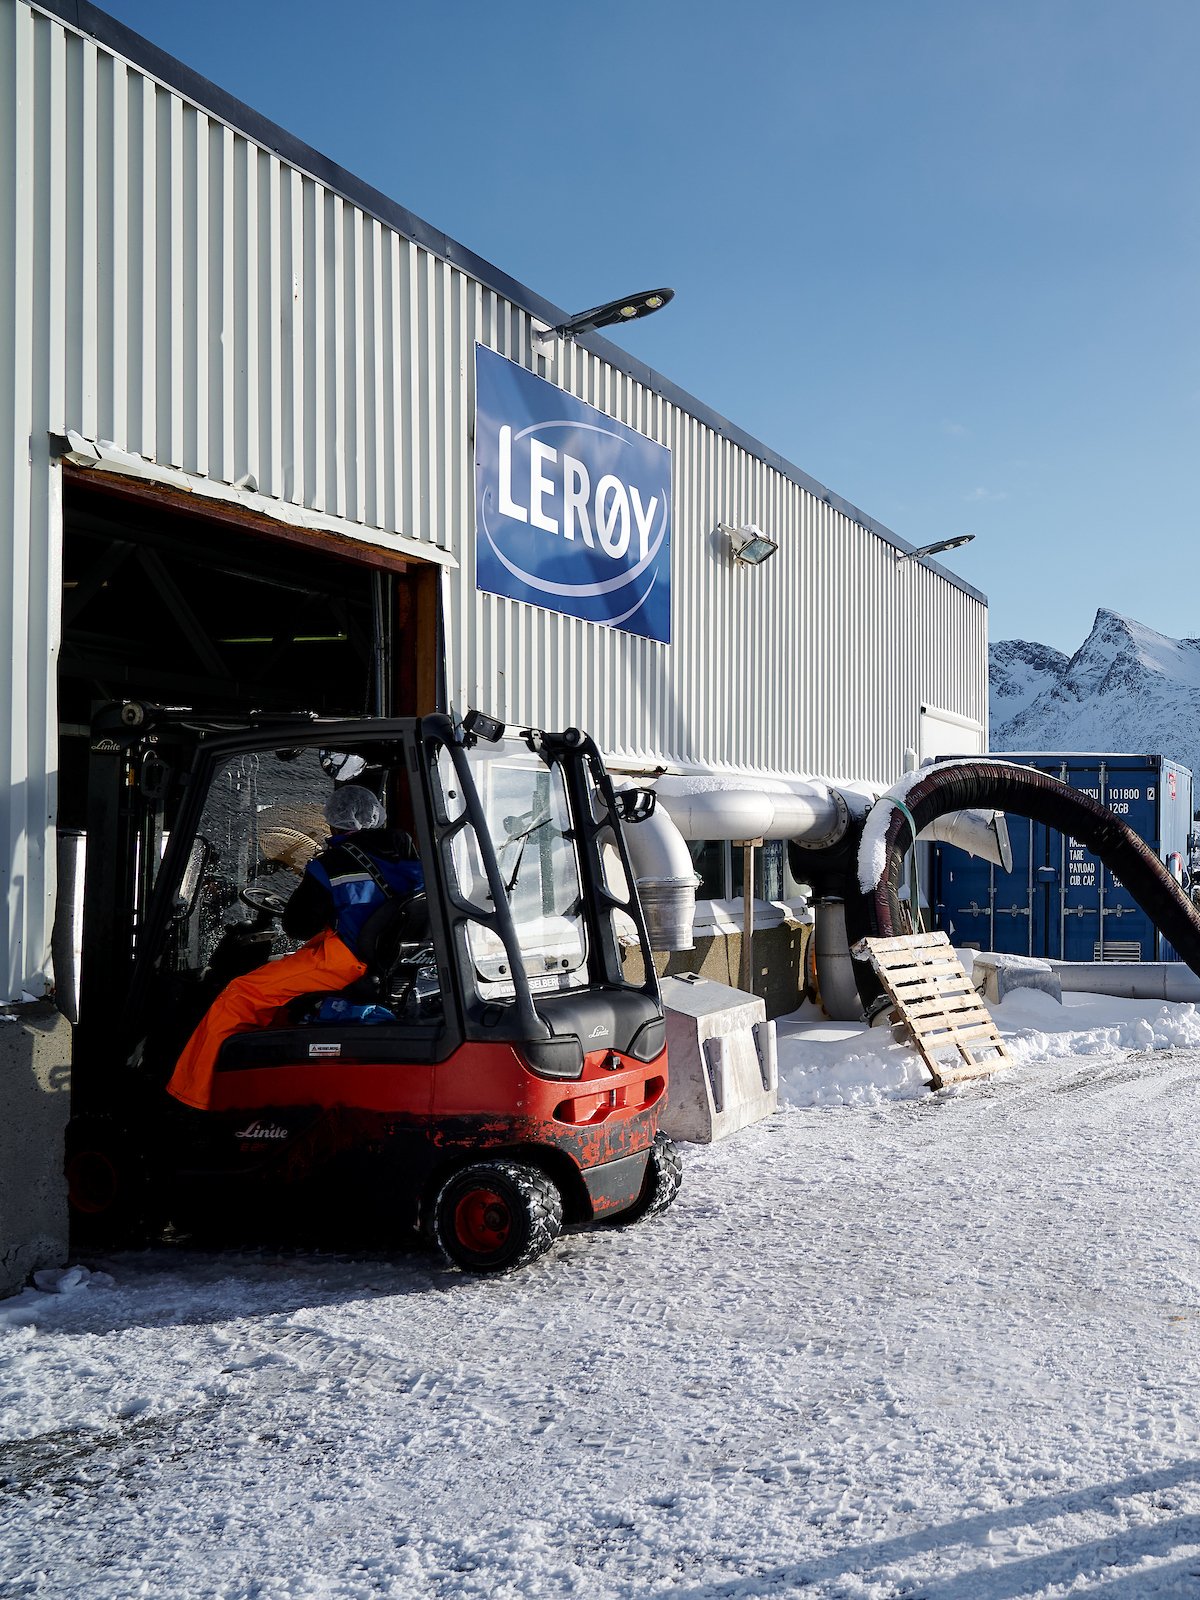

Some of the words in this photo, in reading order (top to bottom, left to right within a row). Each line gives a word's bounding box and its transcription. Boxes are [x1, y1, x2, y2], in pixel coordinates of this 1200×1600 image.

[499, 424, 658, 563] LERØY
[1109, 788, 1139, 800] 101800
[1069, 850, 1084, 861] TARE
[1069, 863, 1095, 874] PAYLOAD
[235, 1120, 288, 1139] Linde
